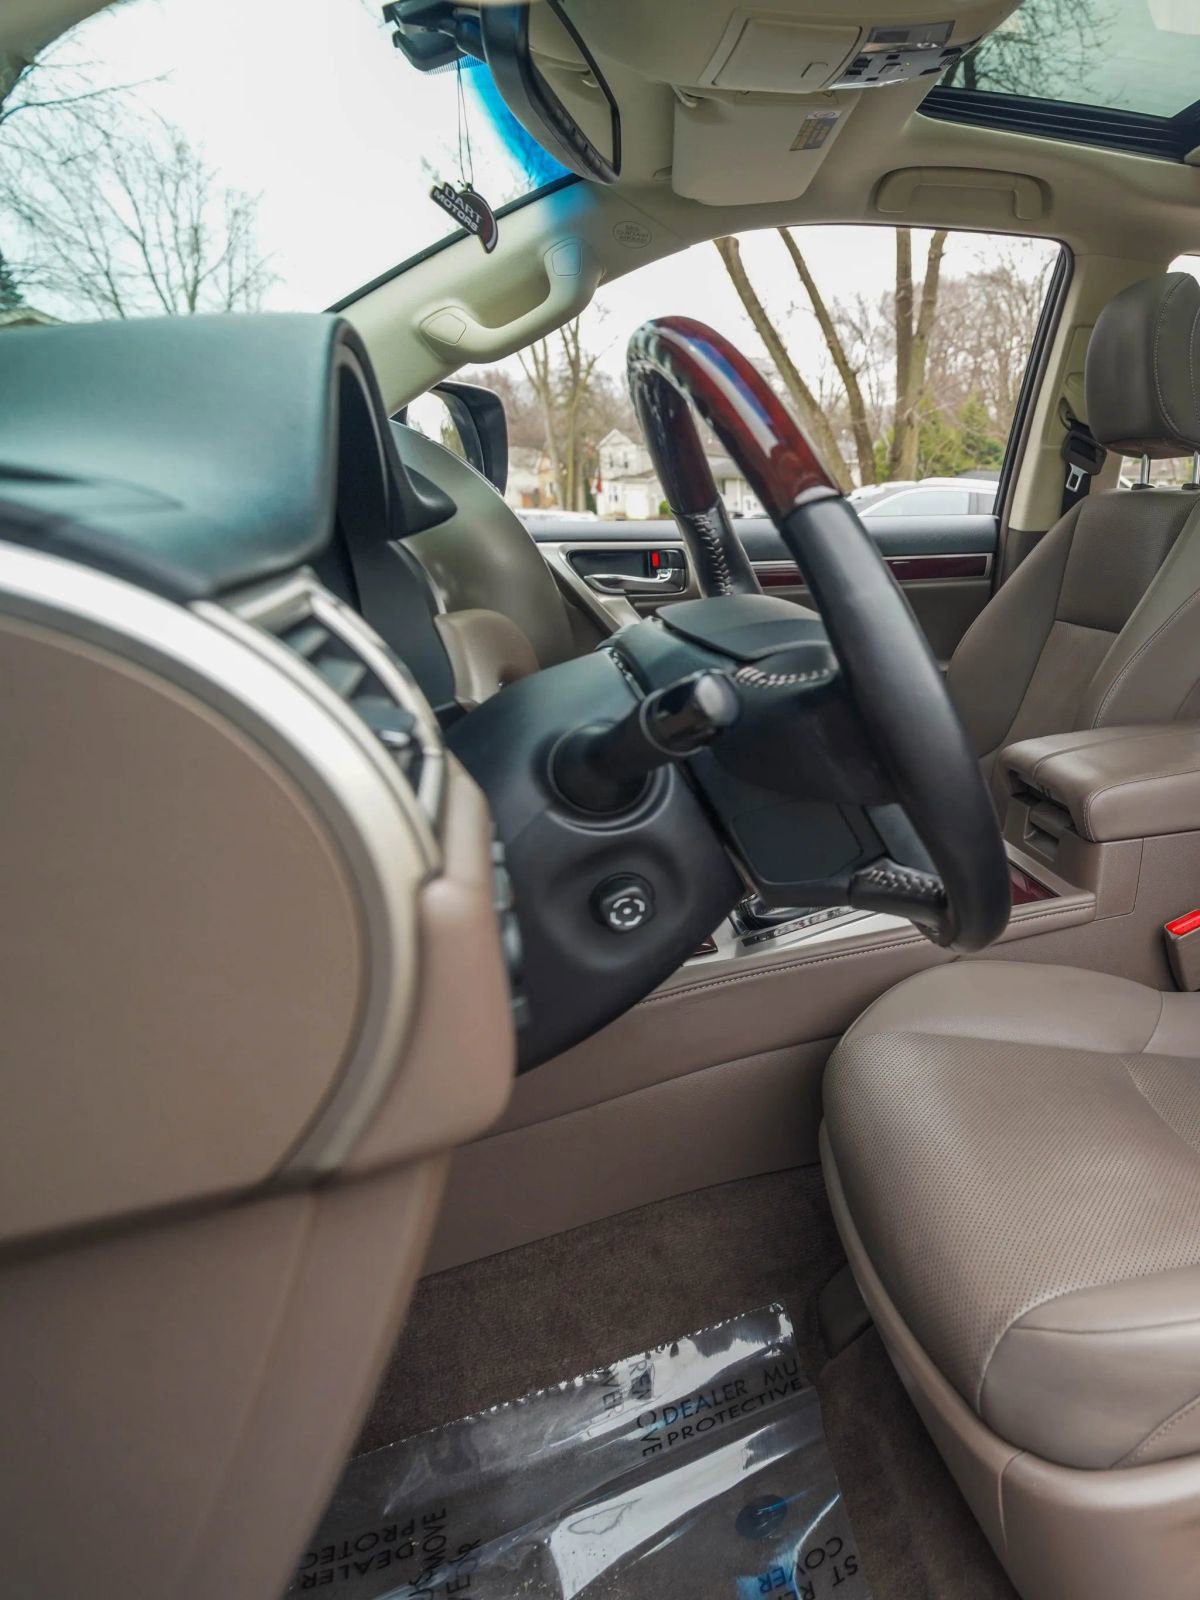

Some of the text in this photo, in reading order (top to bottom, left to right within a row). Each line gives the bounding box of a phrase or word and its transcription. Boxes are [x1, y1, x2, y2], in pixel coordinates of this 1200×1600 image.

[434, 189, 478, 231] MOTORS
[444, 186, 484, 223] DART
[663, 1359, 799, 1426] DEALER MU
[667, 1377, 803, 1447] PROTECTIVE
[301, 1540, 415, 1590] DEALER
[832, 1555, 858, 1588] ST
